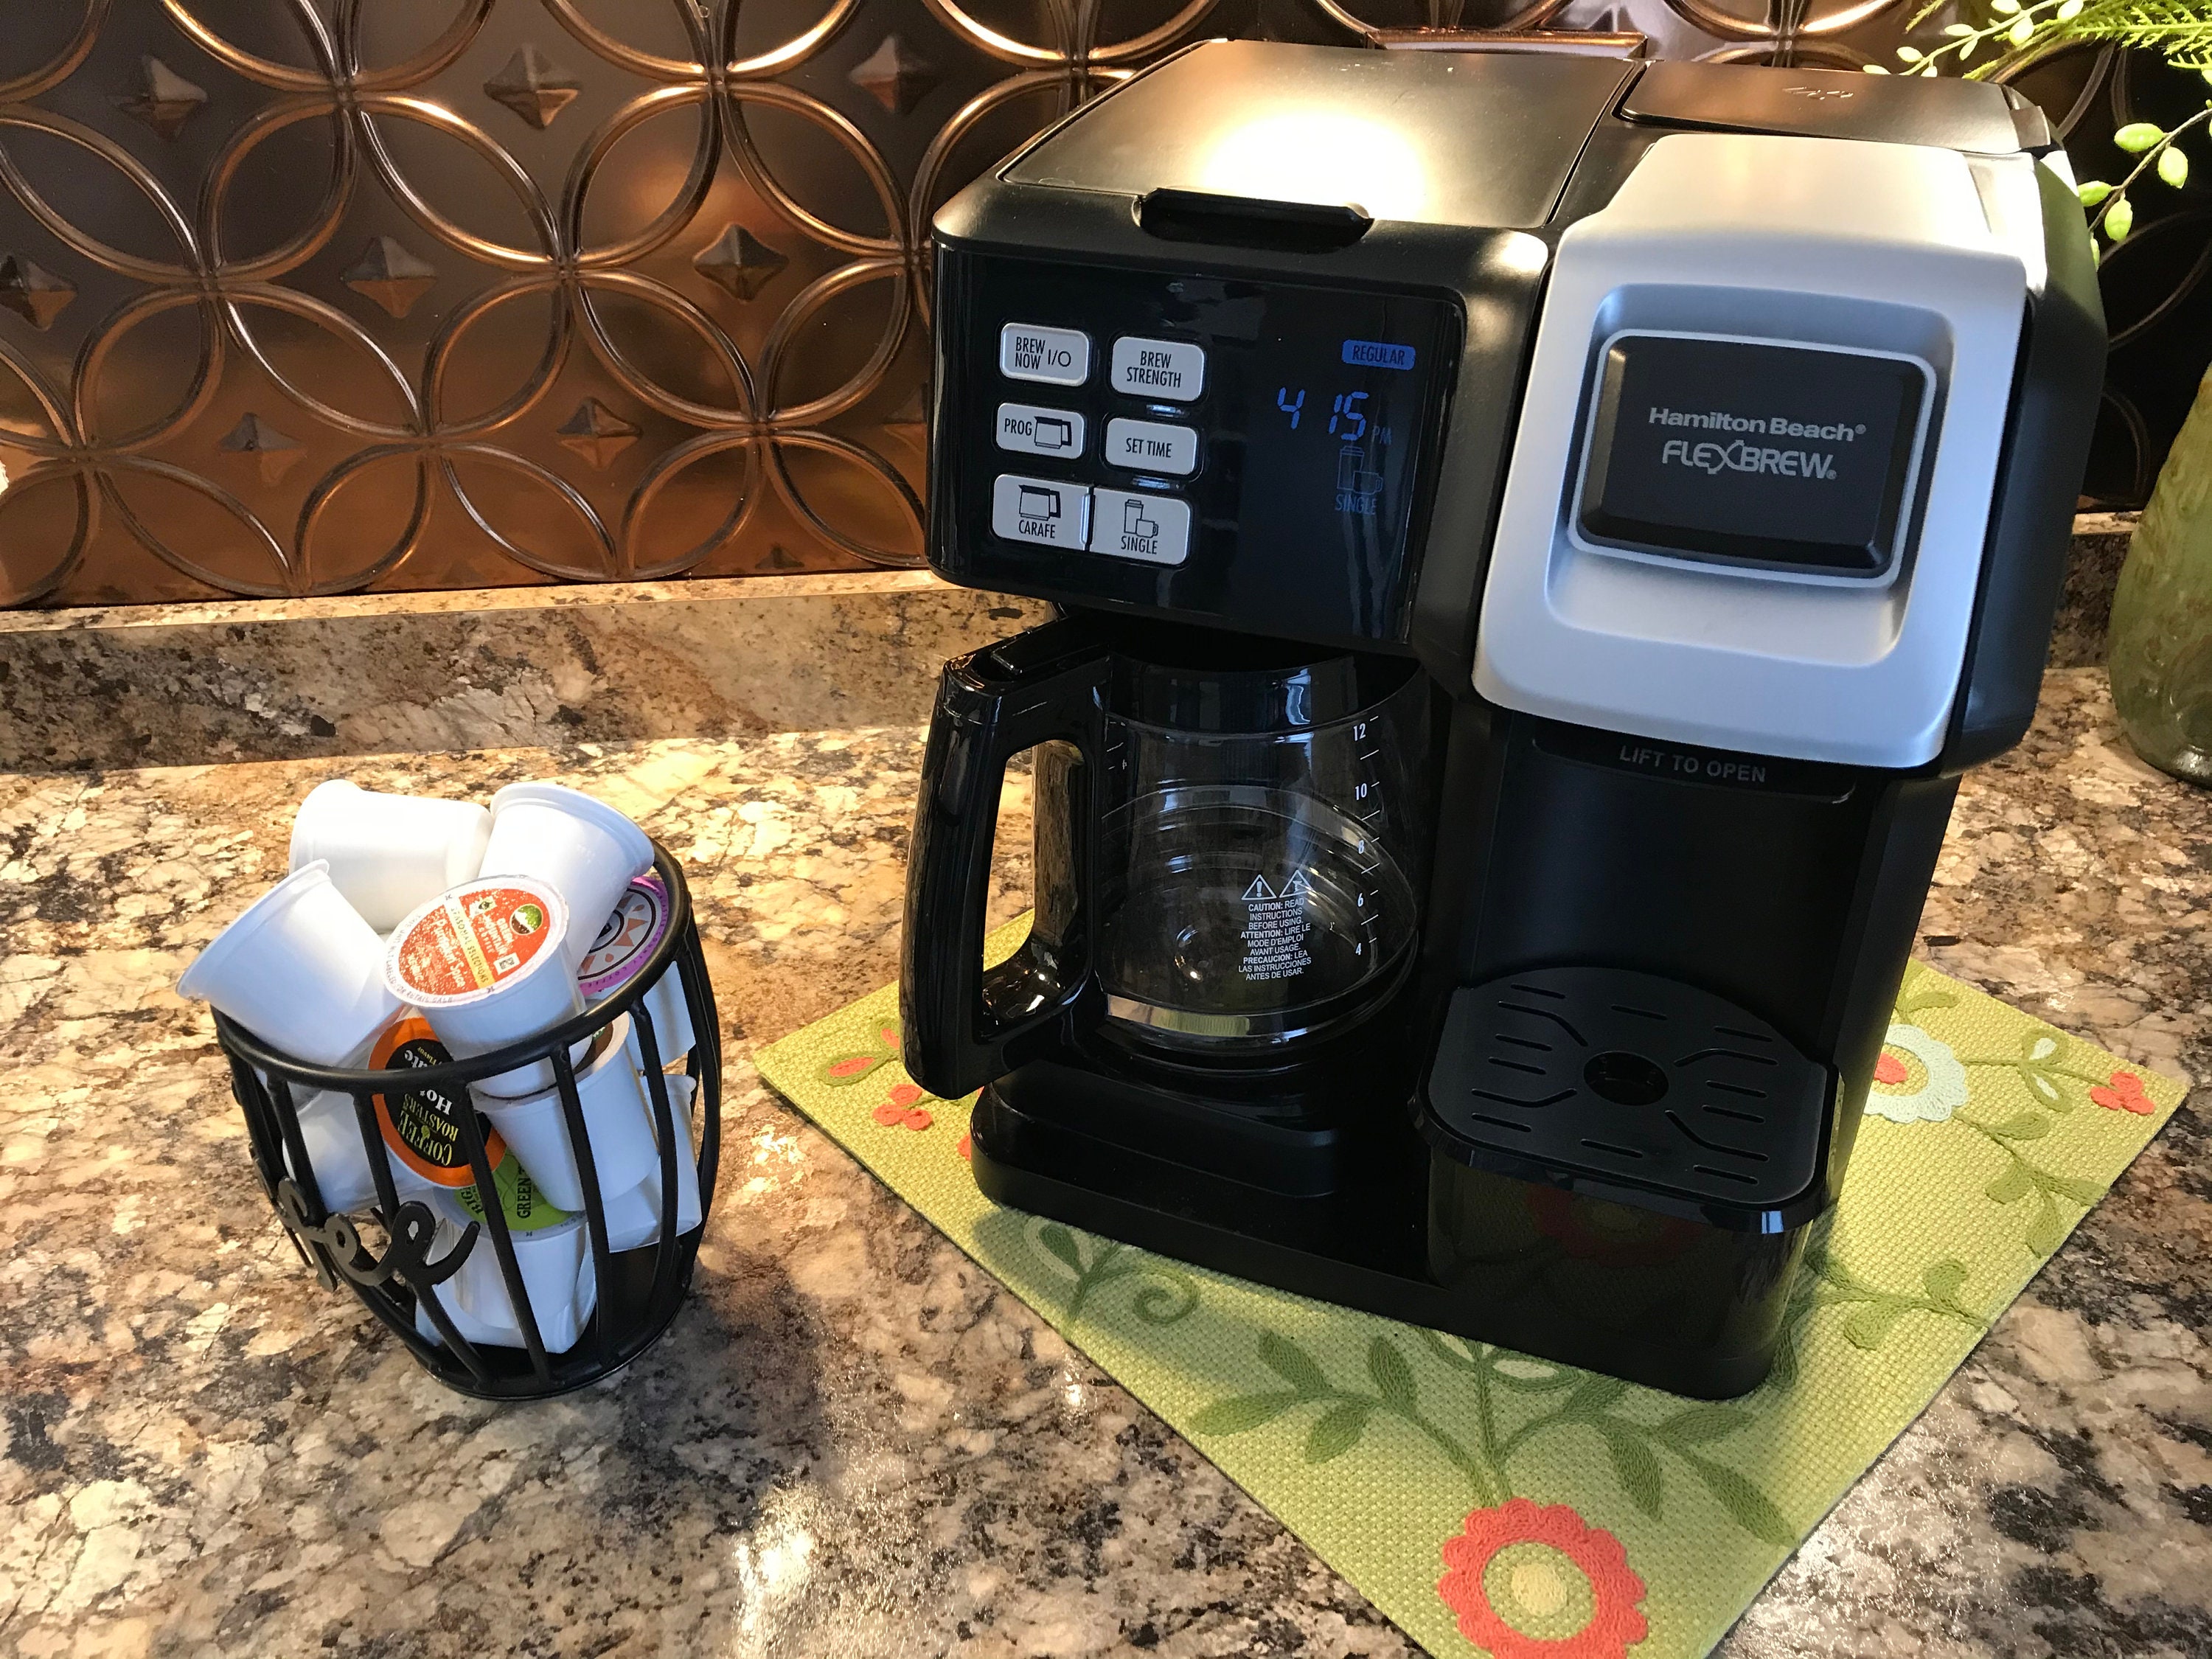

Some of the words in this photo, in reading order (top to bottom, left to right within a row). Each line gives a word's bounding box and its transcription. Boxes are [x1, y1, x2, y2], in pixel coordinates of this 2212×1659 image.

[1015, 337, 1046, 355] BREW
[1015, 352, 1041, 370] NOW
[1140, 350, 1171, 369] BREW
[1352, 347, 1405, 366] REGULAR
[1127, 366, 1181, 389] STRENGTH
[1004, 419, 1032, 437] PROG
[1649, 407, 1766, 434] Hamilton
[1125, 438, 1144, 454] SET
[1147, 440, 1172, 459] TIME
[1335, 493, 1378, 515] SINGLE
[1018, 519, 1056, 539] CARAFE
[1120, 535, 1158, 555] SINGLE
[1353, 723, 1367, 742] 12
[1619, 745, 1666, 768] LIFT
[1672, 754, 1700, 773] TO
[1706, 760, 1767, 783] OPEN
[1354, 784, 1368, 800] 10
[1358, 840, 1366, 855] 8
[1248, 901, 1283, 912] CAUTION:
[1284, 897, 1304, 908] READ
[1357, 894, 1365, 908] 6
[1250, 907, 1303, 921] INSTRUCTIONS
[1240, 930, 1283, 939] ATTENTION:
[1284, 925, 1301, 936] LIRE
[1301, 922, 1311, 931] LE
[1248, 920, 1277, 931] BEFORE
[1248, 938, 1269, 947] MODE
[1270, 933, 1304, 946] D'EMPLOI
[1243, 953, 1293, 964] PRECAUCION:
[1294, 950, 1308, 959] LEA
[1250, 947, 1273, 956] AVANT
[1274, 943, 1301, 954] USAGE.
[1355, 943, 1363, 956] 4
[1238, 964, 1252, 973] LAS
[1253, 957, 1312, 973] INSTRUCCIONES
[1245, 971, 1270, 981] ANTES
[1271, 970, 1281, 979] DE
[1282, 967, 1304, 978] USAR.
[404, 1093, 459, 1142] ROASTERS
[397, 1110, 453, 1166] COFFEE
[517, 1177, 532, 1219] GREEN
